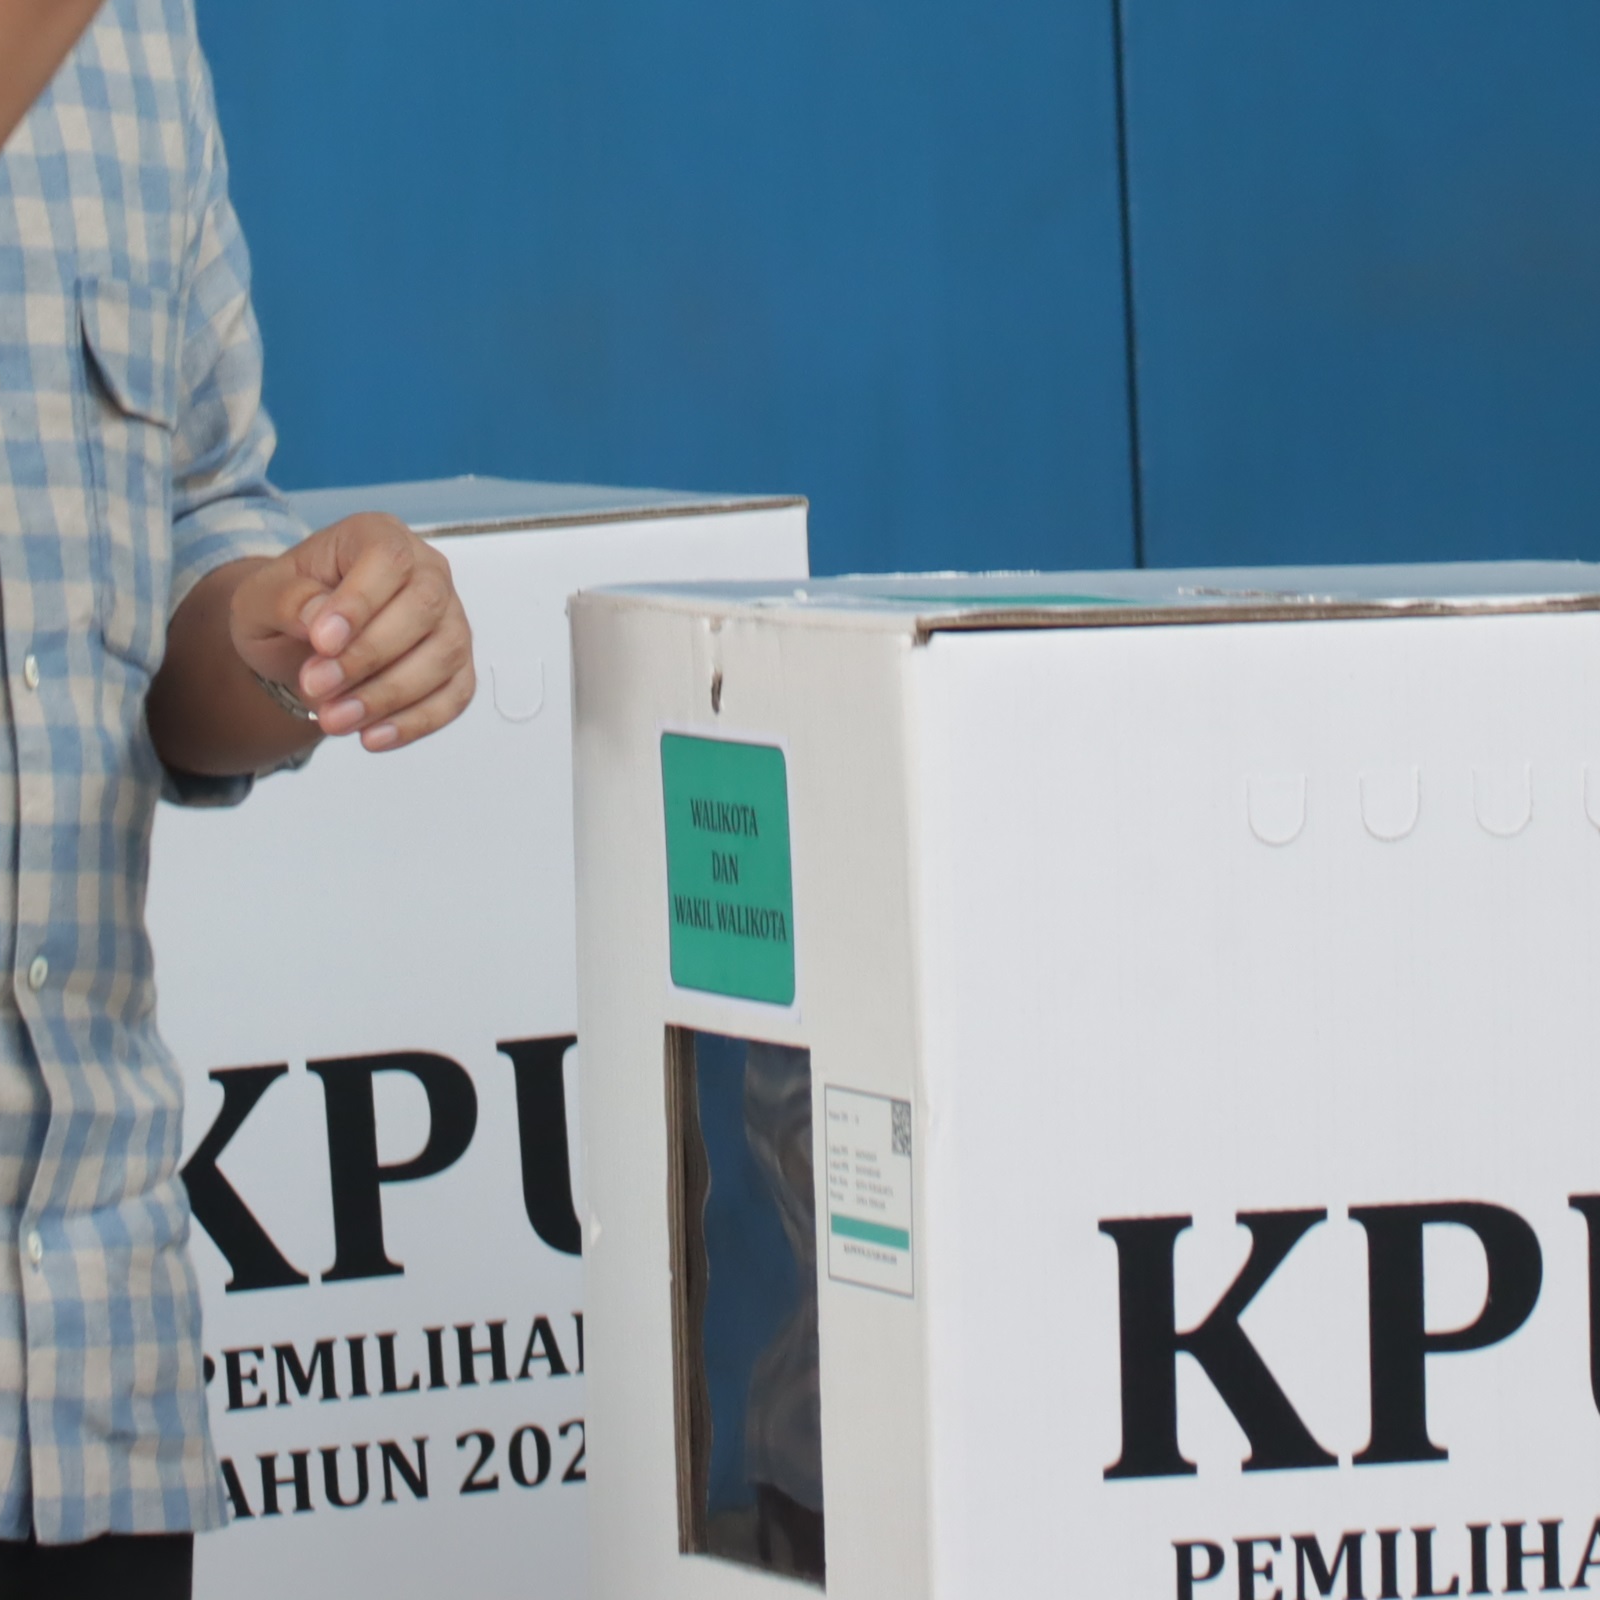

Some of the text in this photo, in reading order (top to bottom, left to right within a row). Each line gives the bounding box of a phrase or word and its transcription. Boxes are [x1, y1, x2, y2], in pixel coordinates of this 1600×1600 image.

[689, 797, 759, 838] WALIKOTA
[711, 850, 739, 885] DAN
[673, 894, 788, 943] WAKIL WALIKOTA
[203, 1311, 584, 1413] EMILIHA
[220, 1418, 587, 1520] AHUN 202
